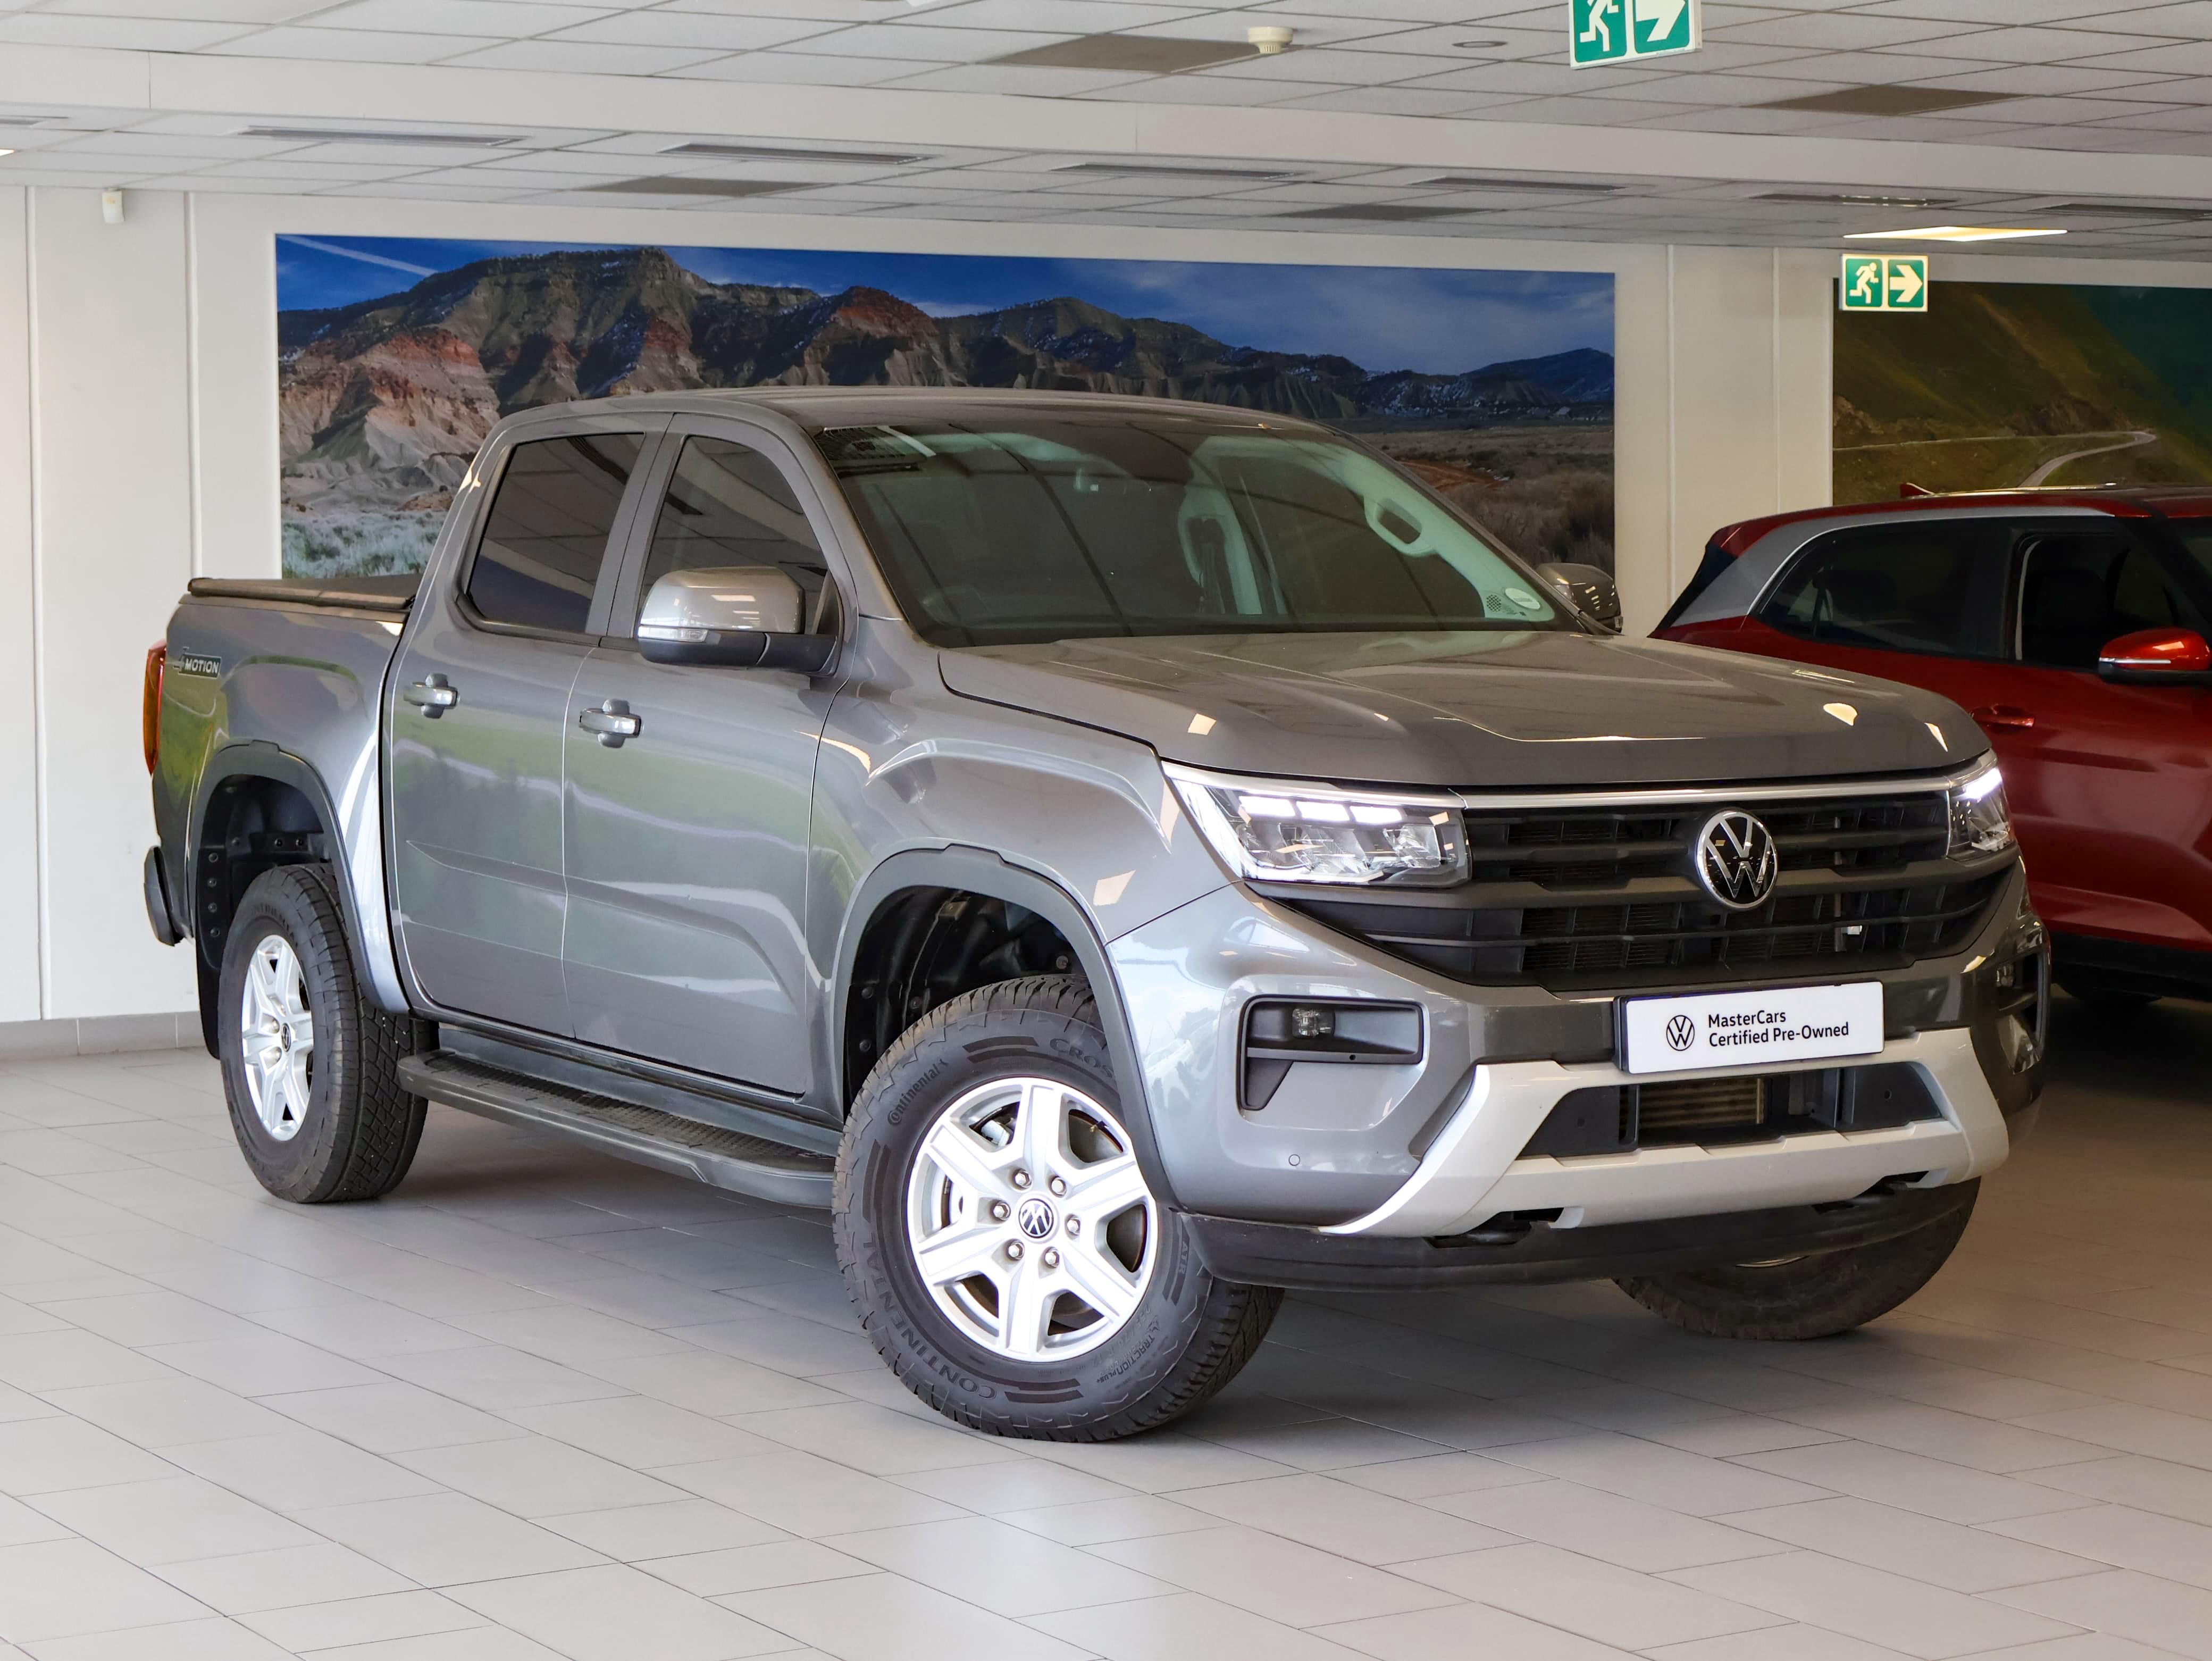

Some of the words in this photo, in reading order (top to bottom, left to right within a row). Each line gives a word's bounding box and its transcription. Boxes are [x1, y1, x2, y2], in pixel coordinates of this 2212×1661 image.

[1708, 1009, 1787, 1028] MasterCars
[1709, 1029, 1770, 1047] Certified
[1773, 1022, 1849, 1042] Pre-Owned
[887, 1063, 941, 1125] Continental
[862, 1231, 998, 1400] CONTINENTAL
[1115, 1334, 1156, 1375] TRACTION
